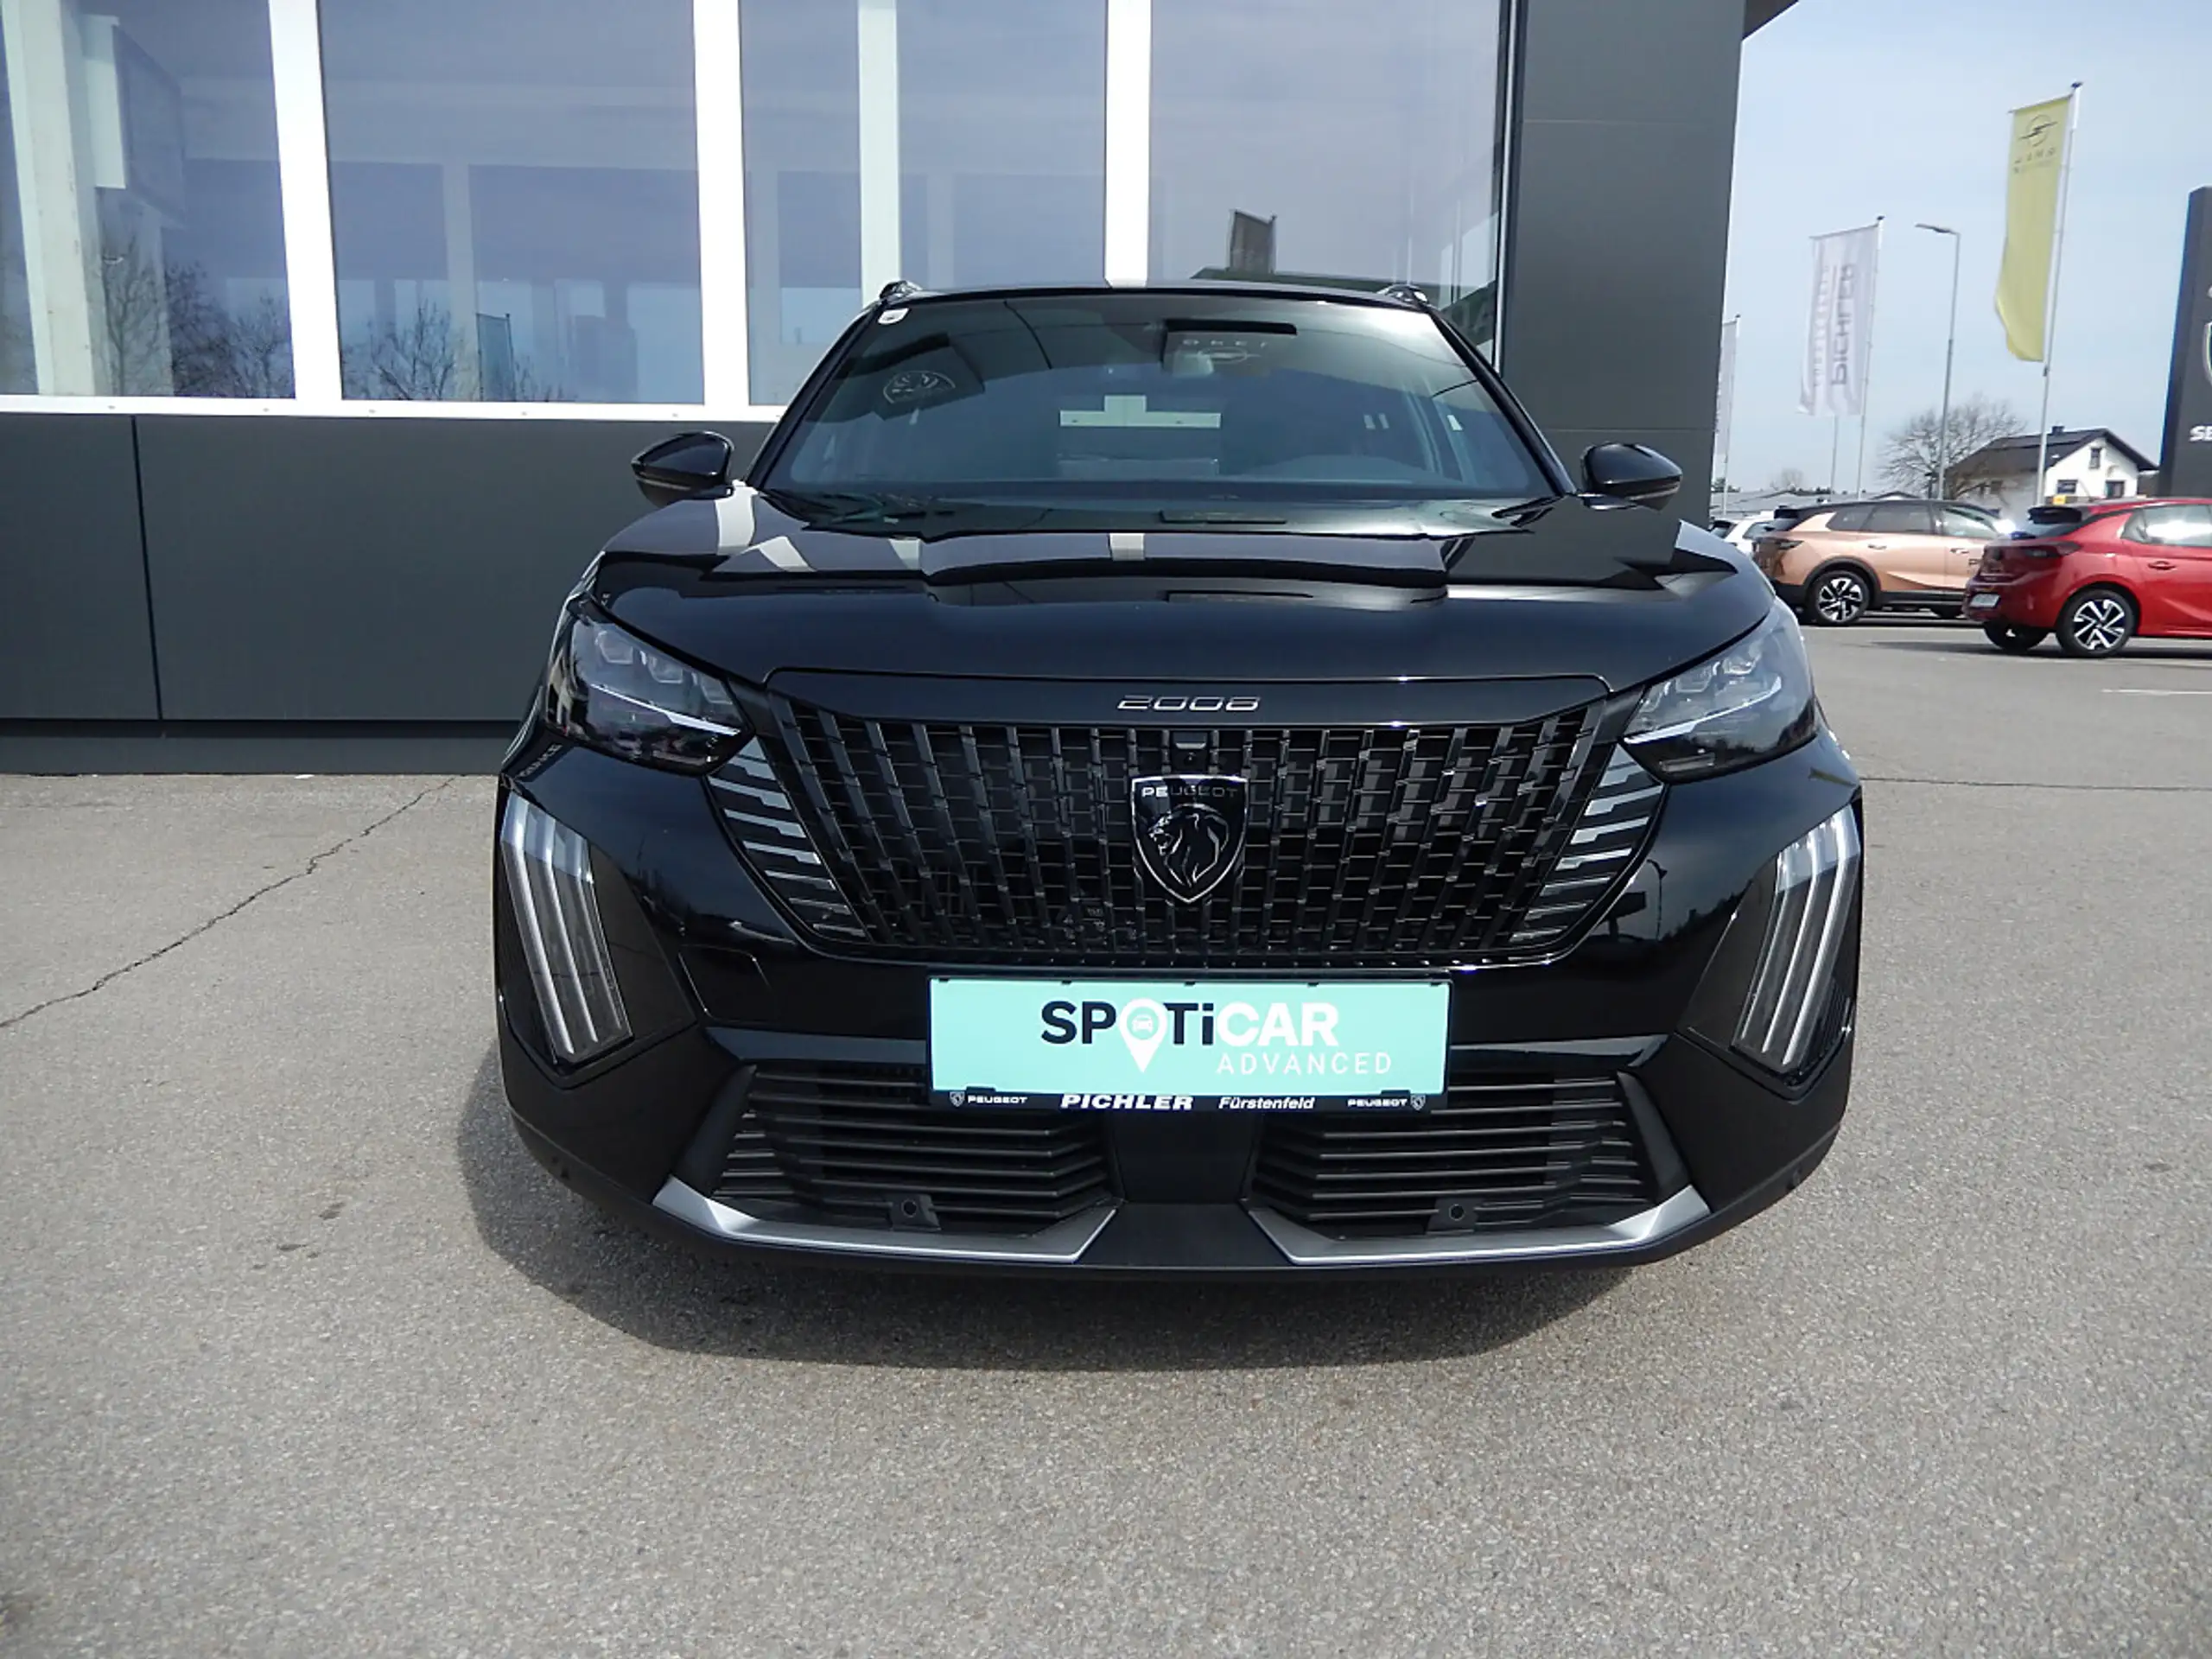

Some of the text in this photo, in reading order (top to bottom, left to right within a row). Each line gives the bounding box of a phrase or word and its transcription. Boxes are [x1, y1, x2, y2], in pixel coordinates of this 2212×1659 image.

[1117, 695, 1261, 711] 2008
[1216, 1051, 1392, 1075] ADVANCED
[967, 1095, 1028, 1104] PEUGEOT
[1060, 1093, 1315, 1110] PICHLER Fürstenfeld
[1347, 1098, 1408, 1108] PEUGEOT
